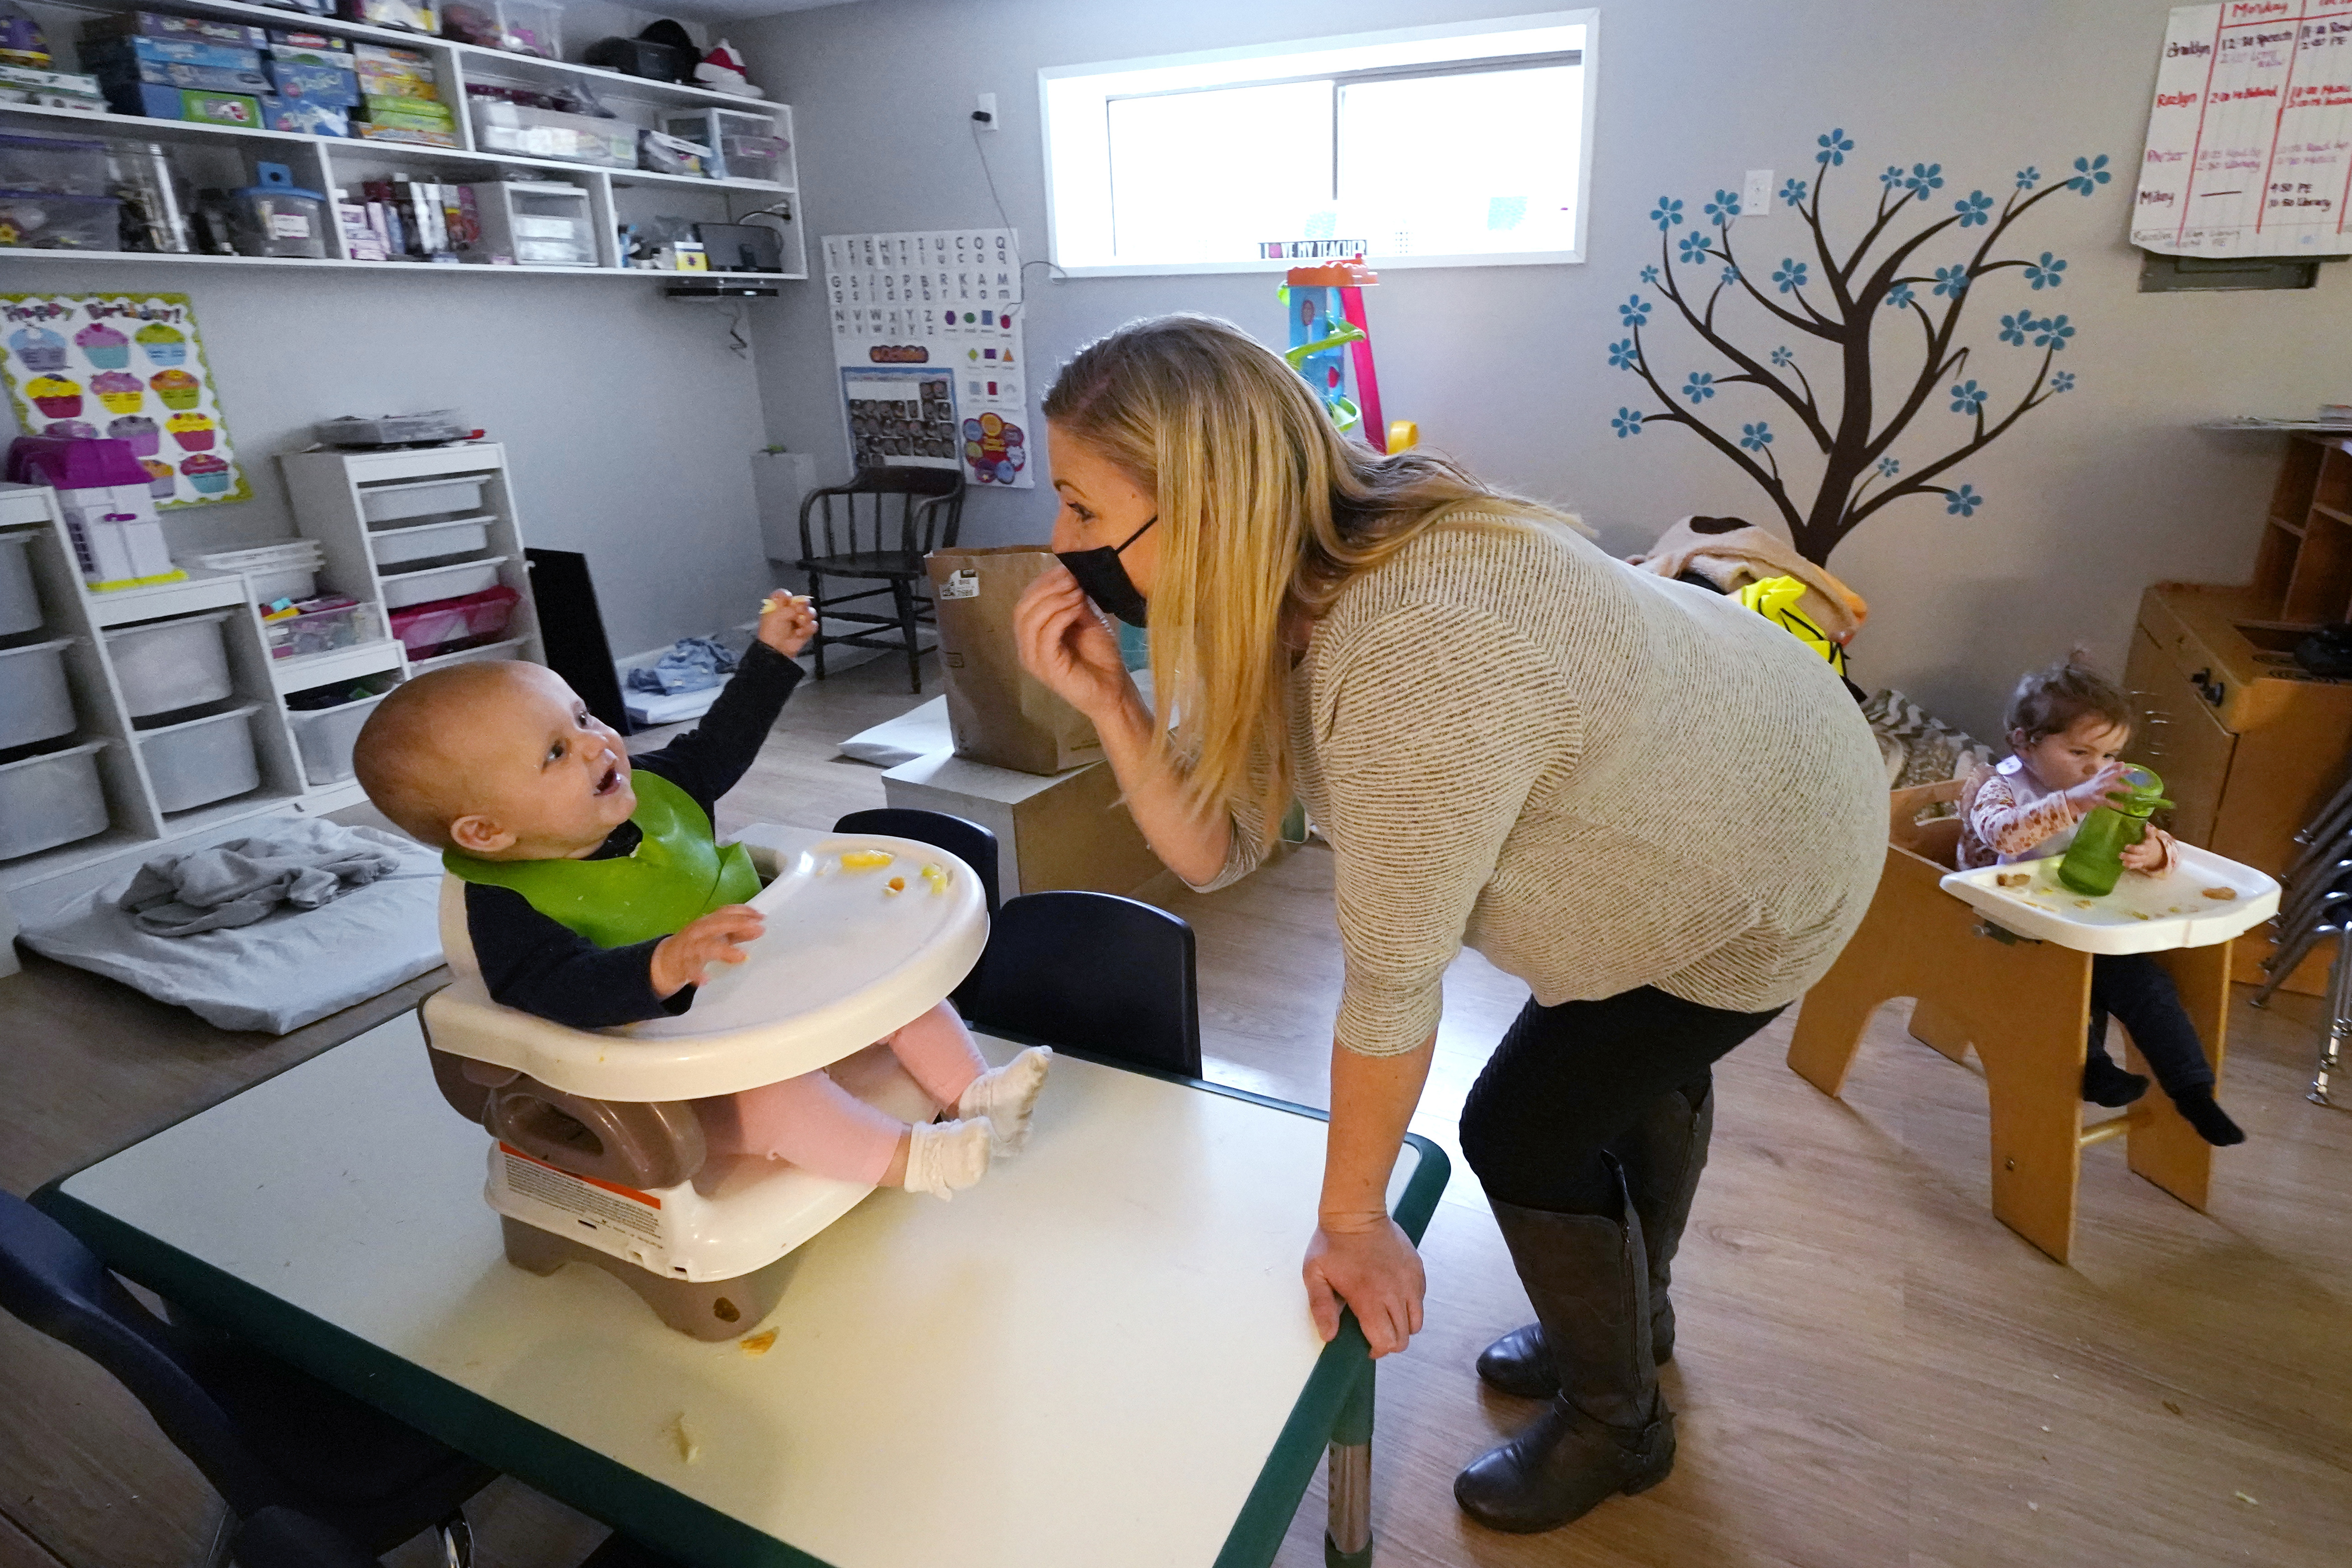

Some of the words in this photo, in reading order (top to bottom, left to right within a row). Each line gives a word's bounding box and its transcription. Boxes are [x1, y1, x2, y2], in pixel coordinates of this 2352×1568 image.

[2232, 3, 2288, 17] Monday
[936, 238, 944, 250] U
[956, 237, 964, 250] C
[974, 237, 984, 250] O
[996, 236, 1005, 249] Q
[1297, 241, 1314, 258] MY
[831, 276, 841, 287] G
[997, 273, 1008, 285] M
